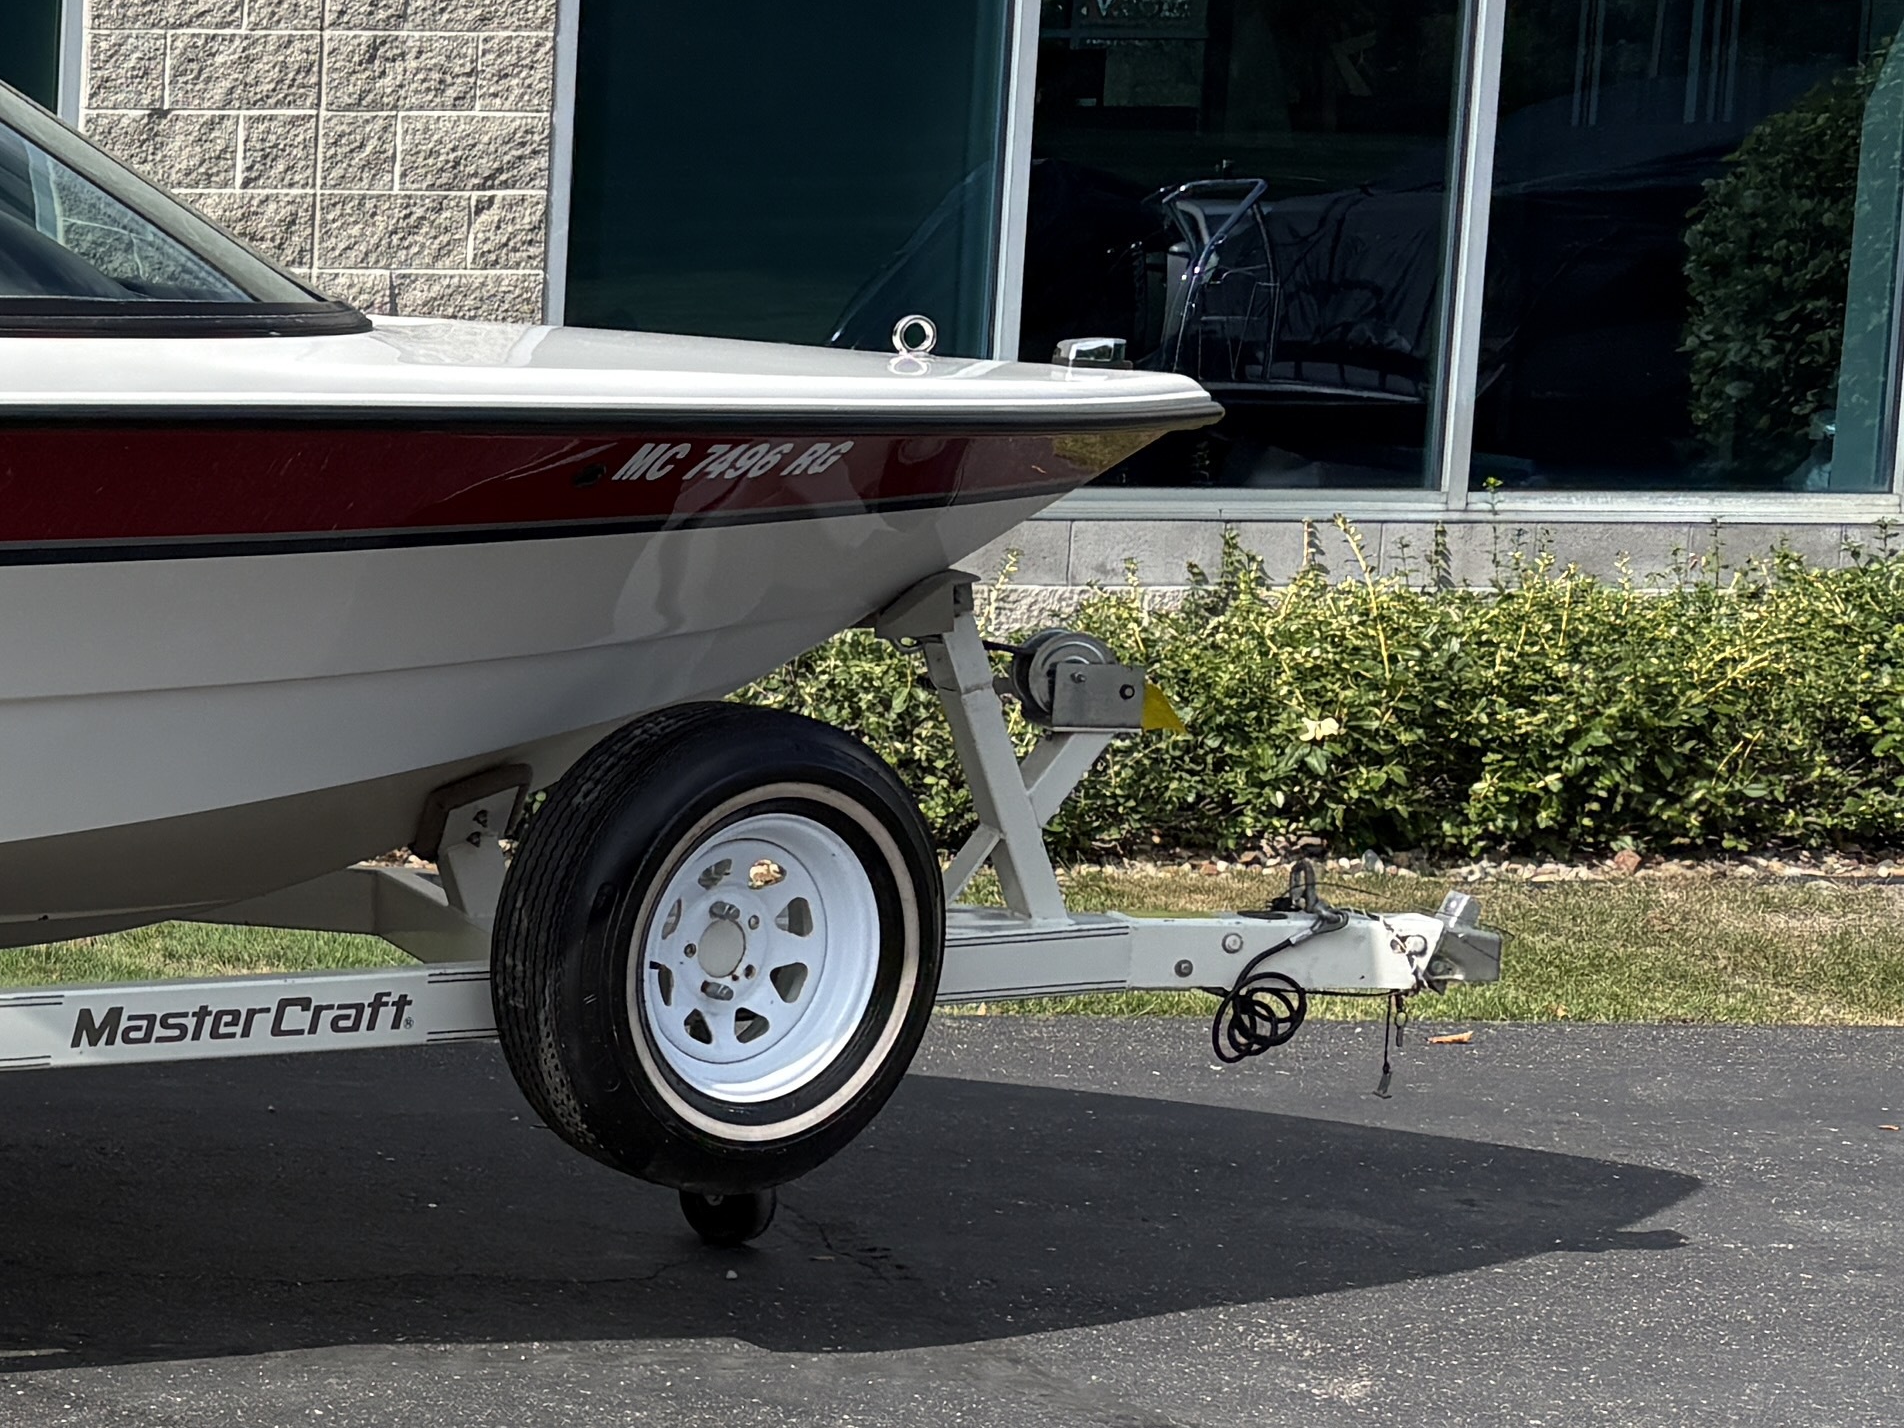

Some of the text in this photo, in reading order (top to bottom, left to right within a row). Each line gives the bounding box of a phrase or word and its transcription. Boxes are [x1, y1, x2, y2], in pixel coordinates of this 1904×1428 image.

[611, 440, 855, 481] MC 7496 RG
[70, 991, 413, 1049] MasterCraft
